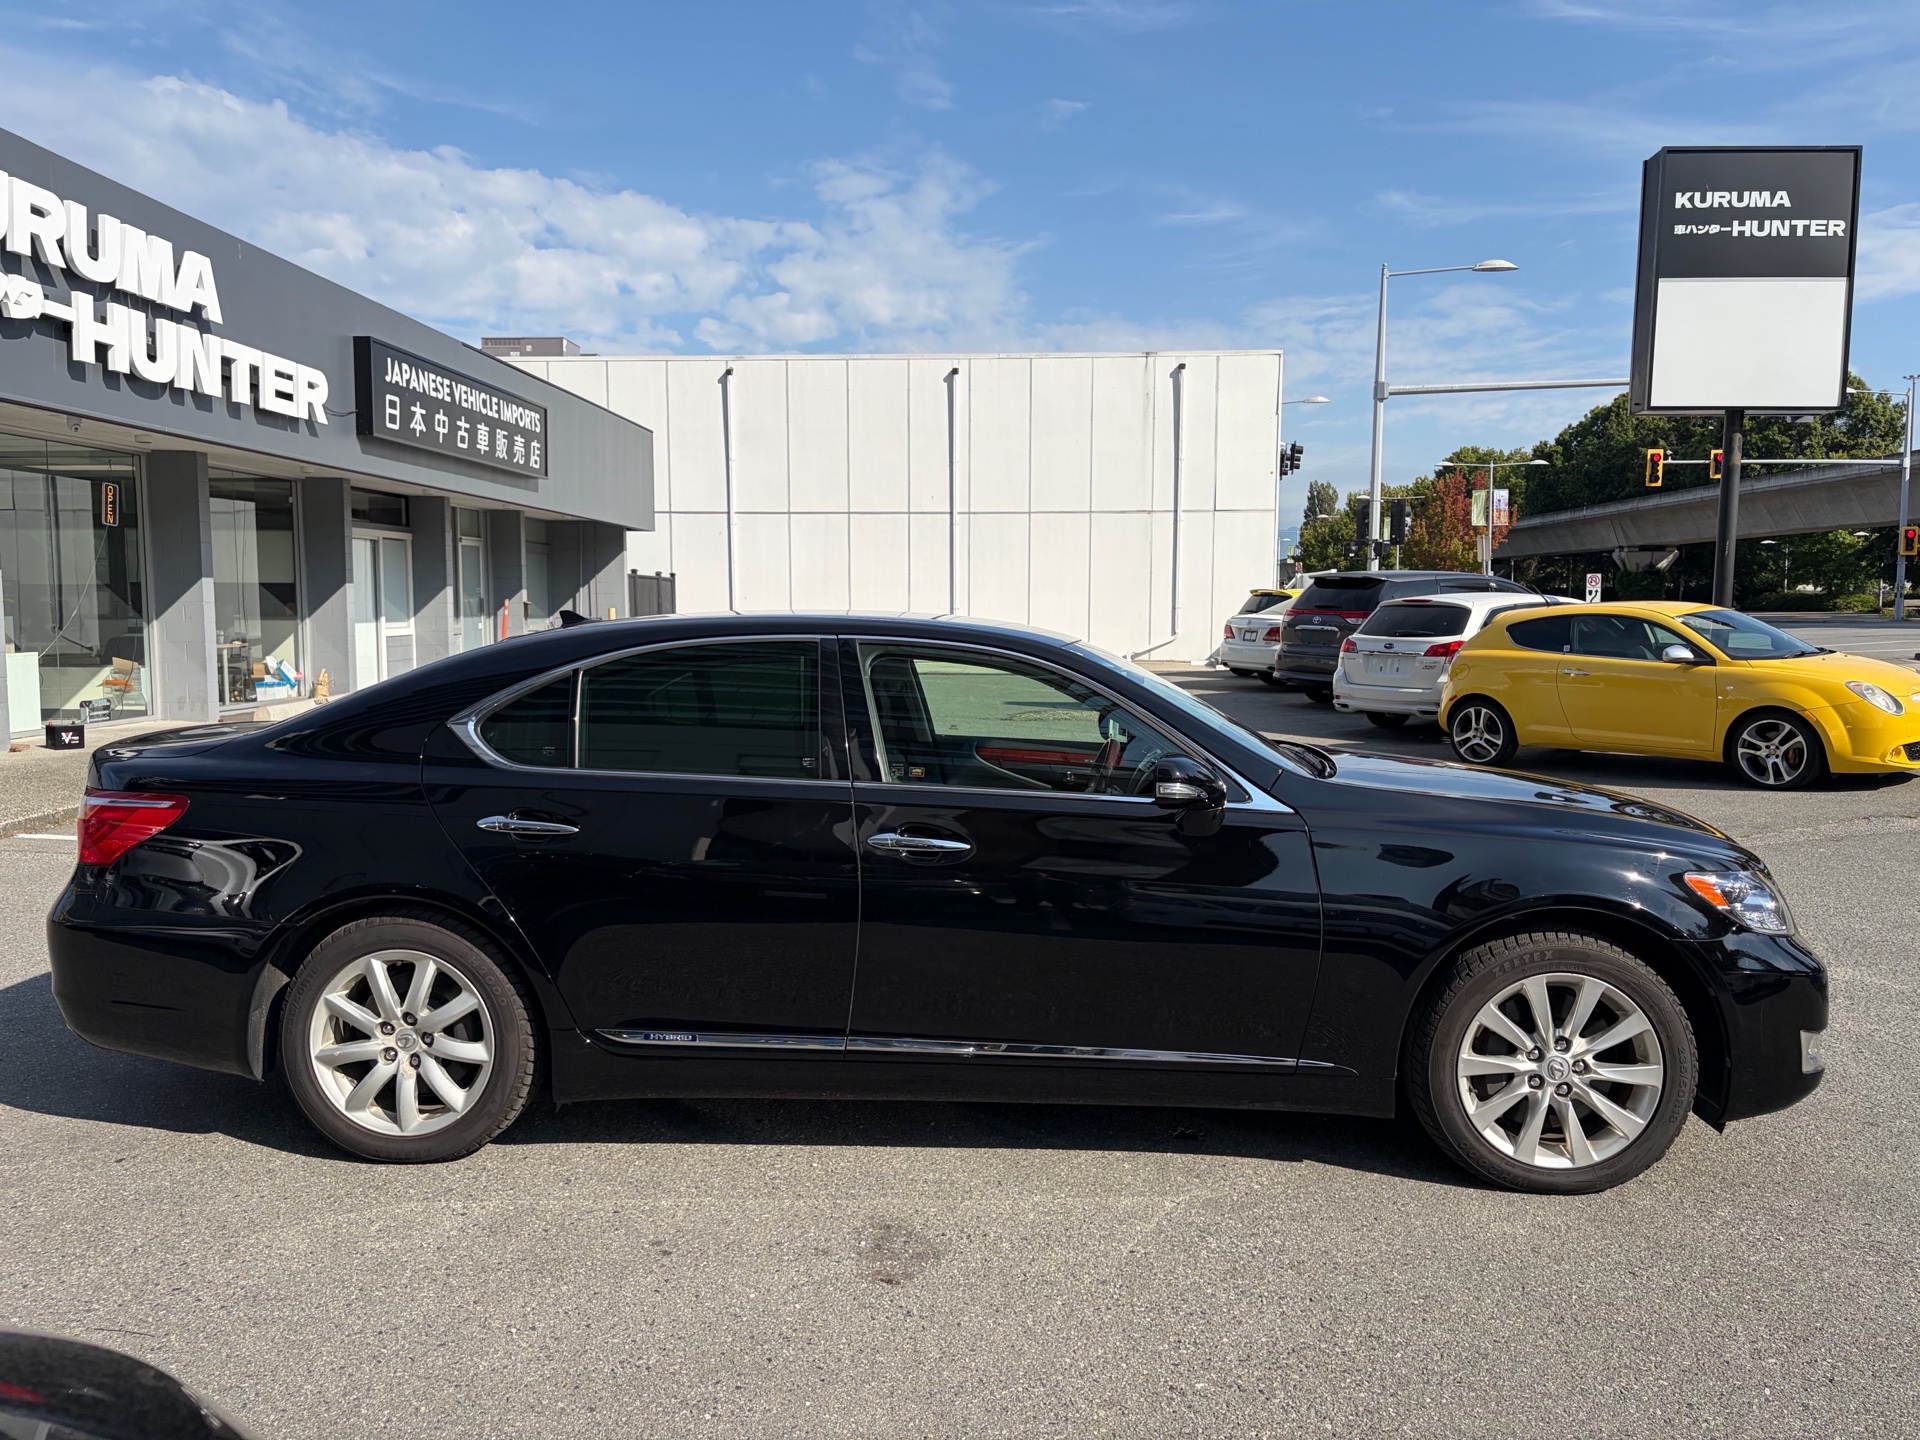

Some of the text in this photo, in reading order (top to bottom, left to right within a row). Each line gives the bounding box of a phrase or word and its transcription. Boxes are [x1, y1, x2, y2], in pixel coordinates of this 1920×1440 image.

[1675, 191, 1791, 209] KURUMA
[0, 170, 223, 324] RUMA
[1732, 219, 1846, 237] HUNTER
[71, 291, 328, 425] HUNTER
[385, 357, 541, 433] JAPANESE VEHICLE IMPORTS
[385, 394, 541, 469] 日本中古車販売店
[1492, 950, 1554, 978] ZEETEX
[649, 1033, 693, 1041] HYBRID
